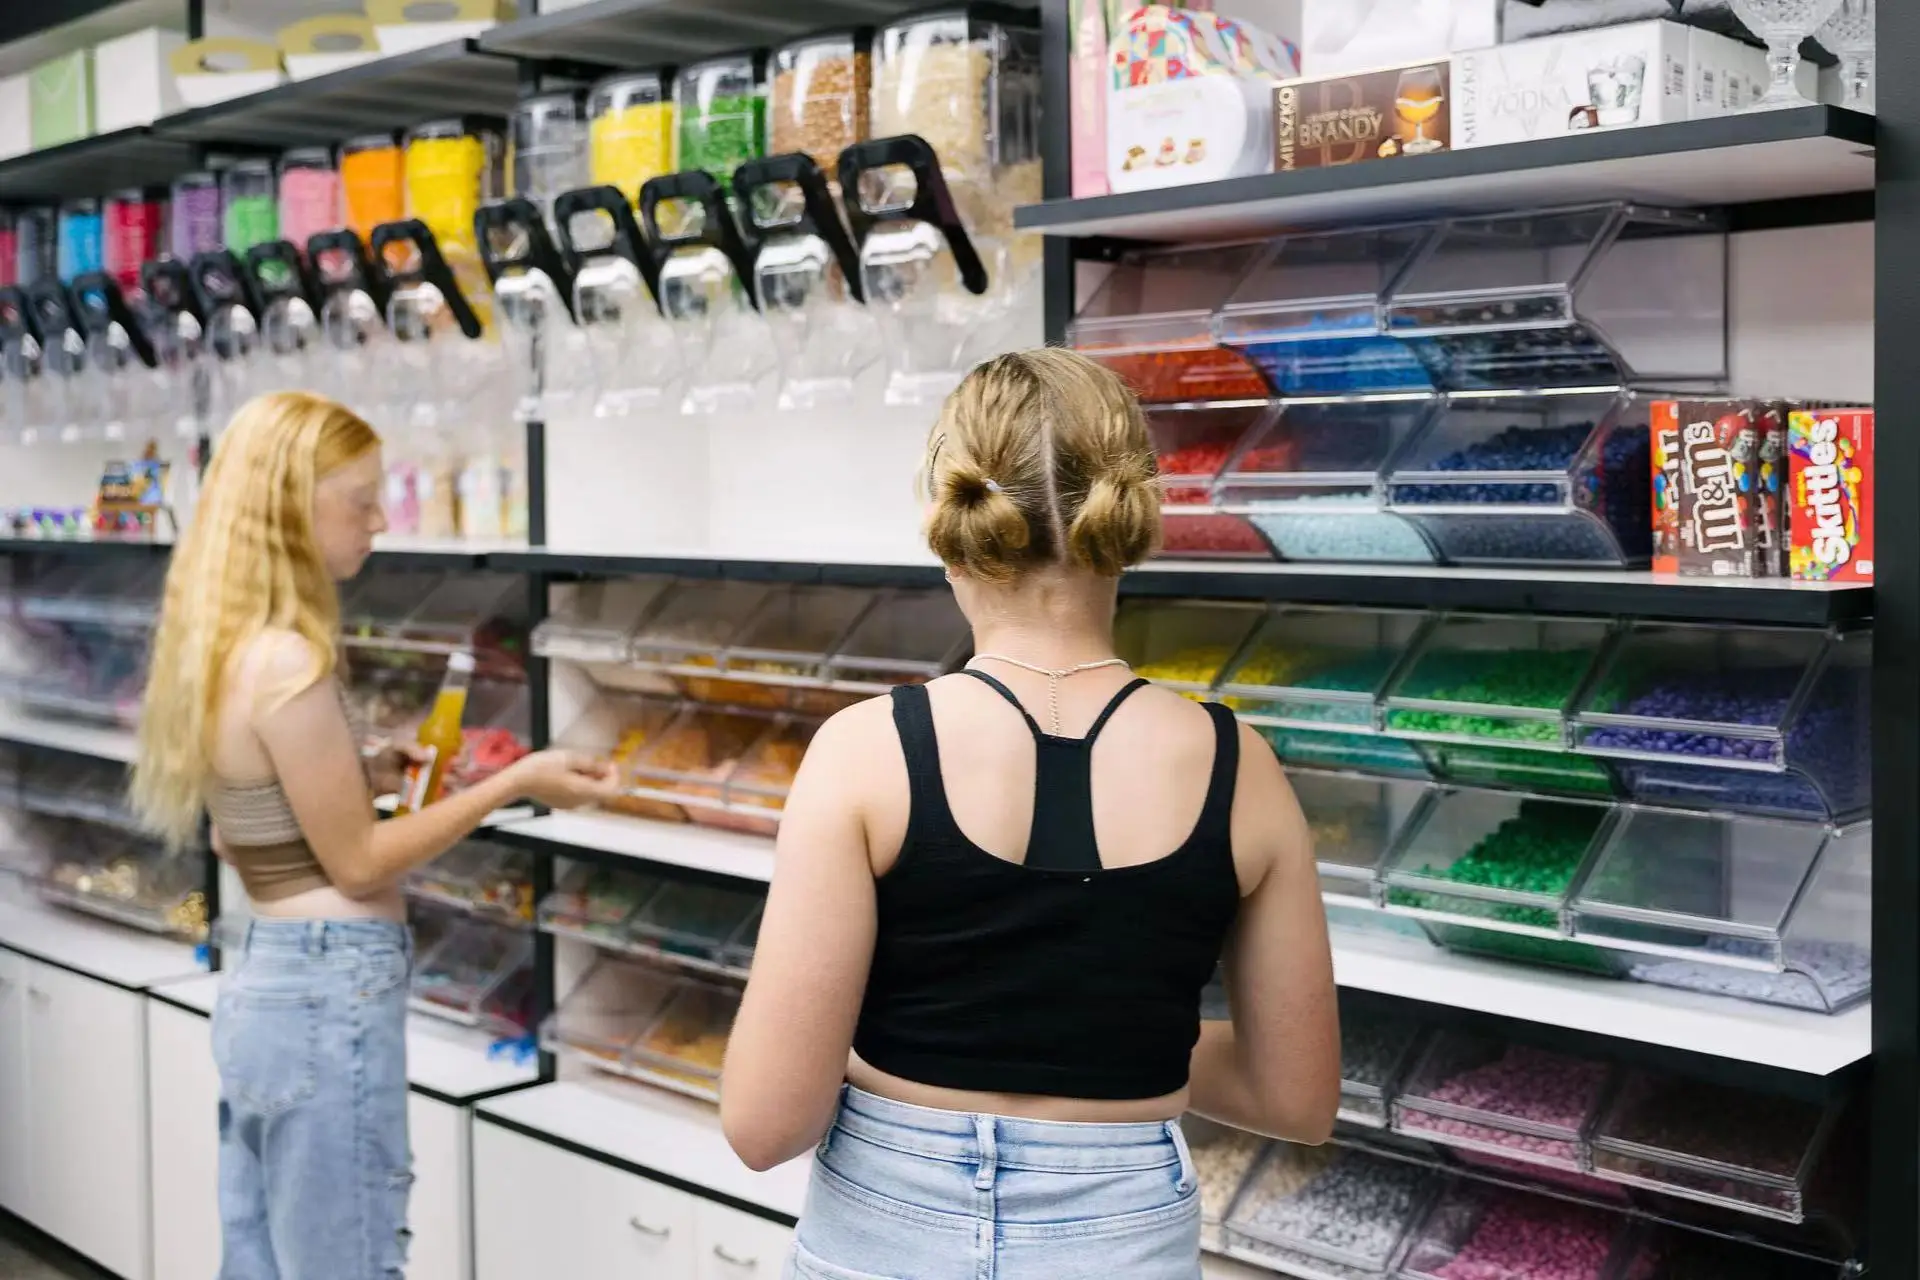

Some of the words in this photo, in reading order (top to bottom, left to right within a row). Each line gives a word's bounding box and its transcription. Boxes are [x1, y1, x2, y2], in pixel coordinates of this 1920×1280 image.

[1278, 87, 1295, 171] MIESZKO
[1300, 113, 1383, 147] BRANDY
[1462, 56, 1477, 144] MIESZKO
[1488, 84, 1572, 117] VODKA
[1806, 418, 1850, 564] Skittles
